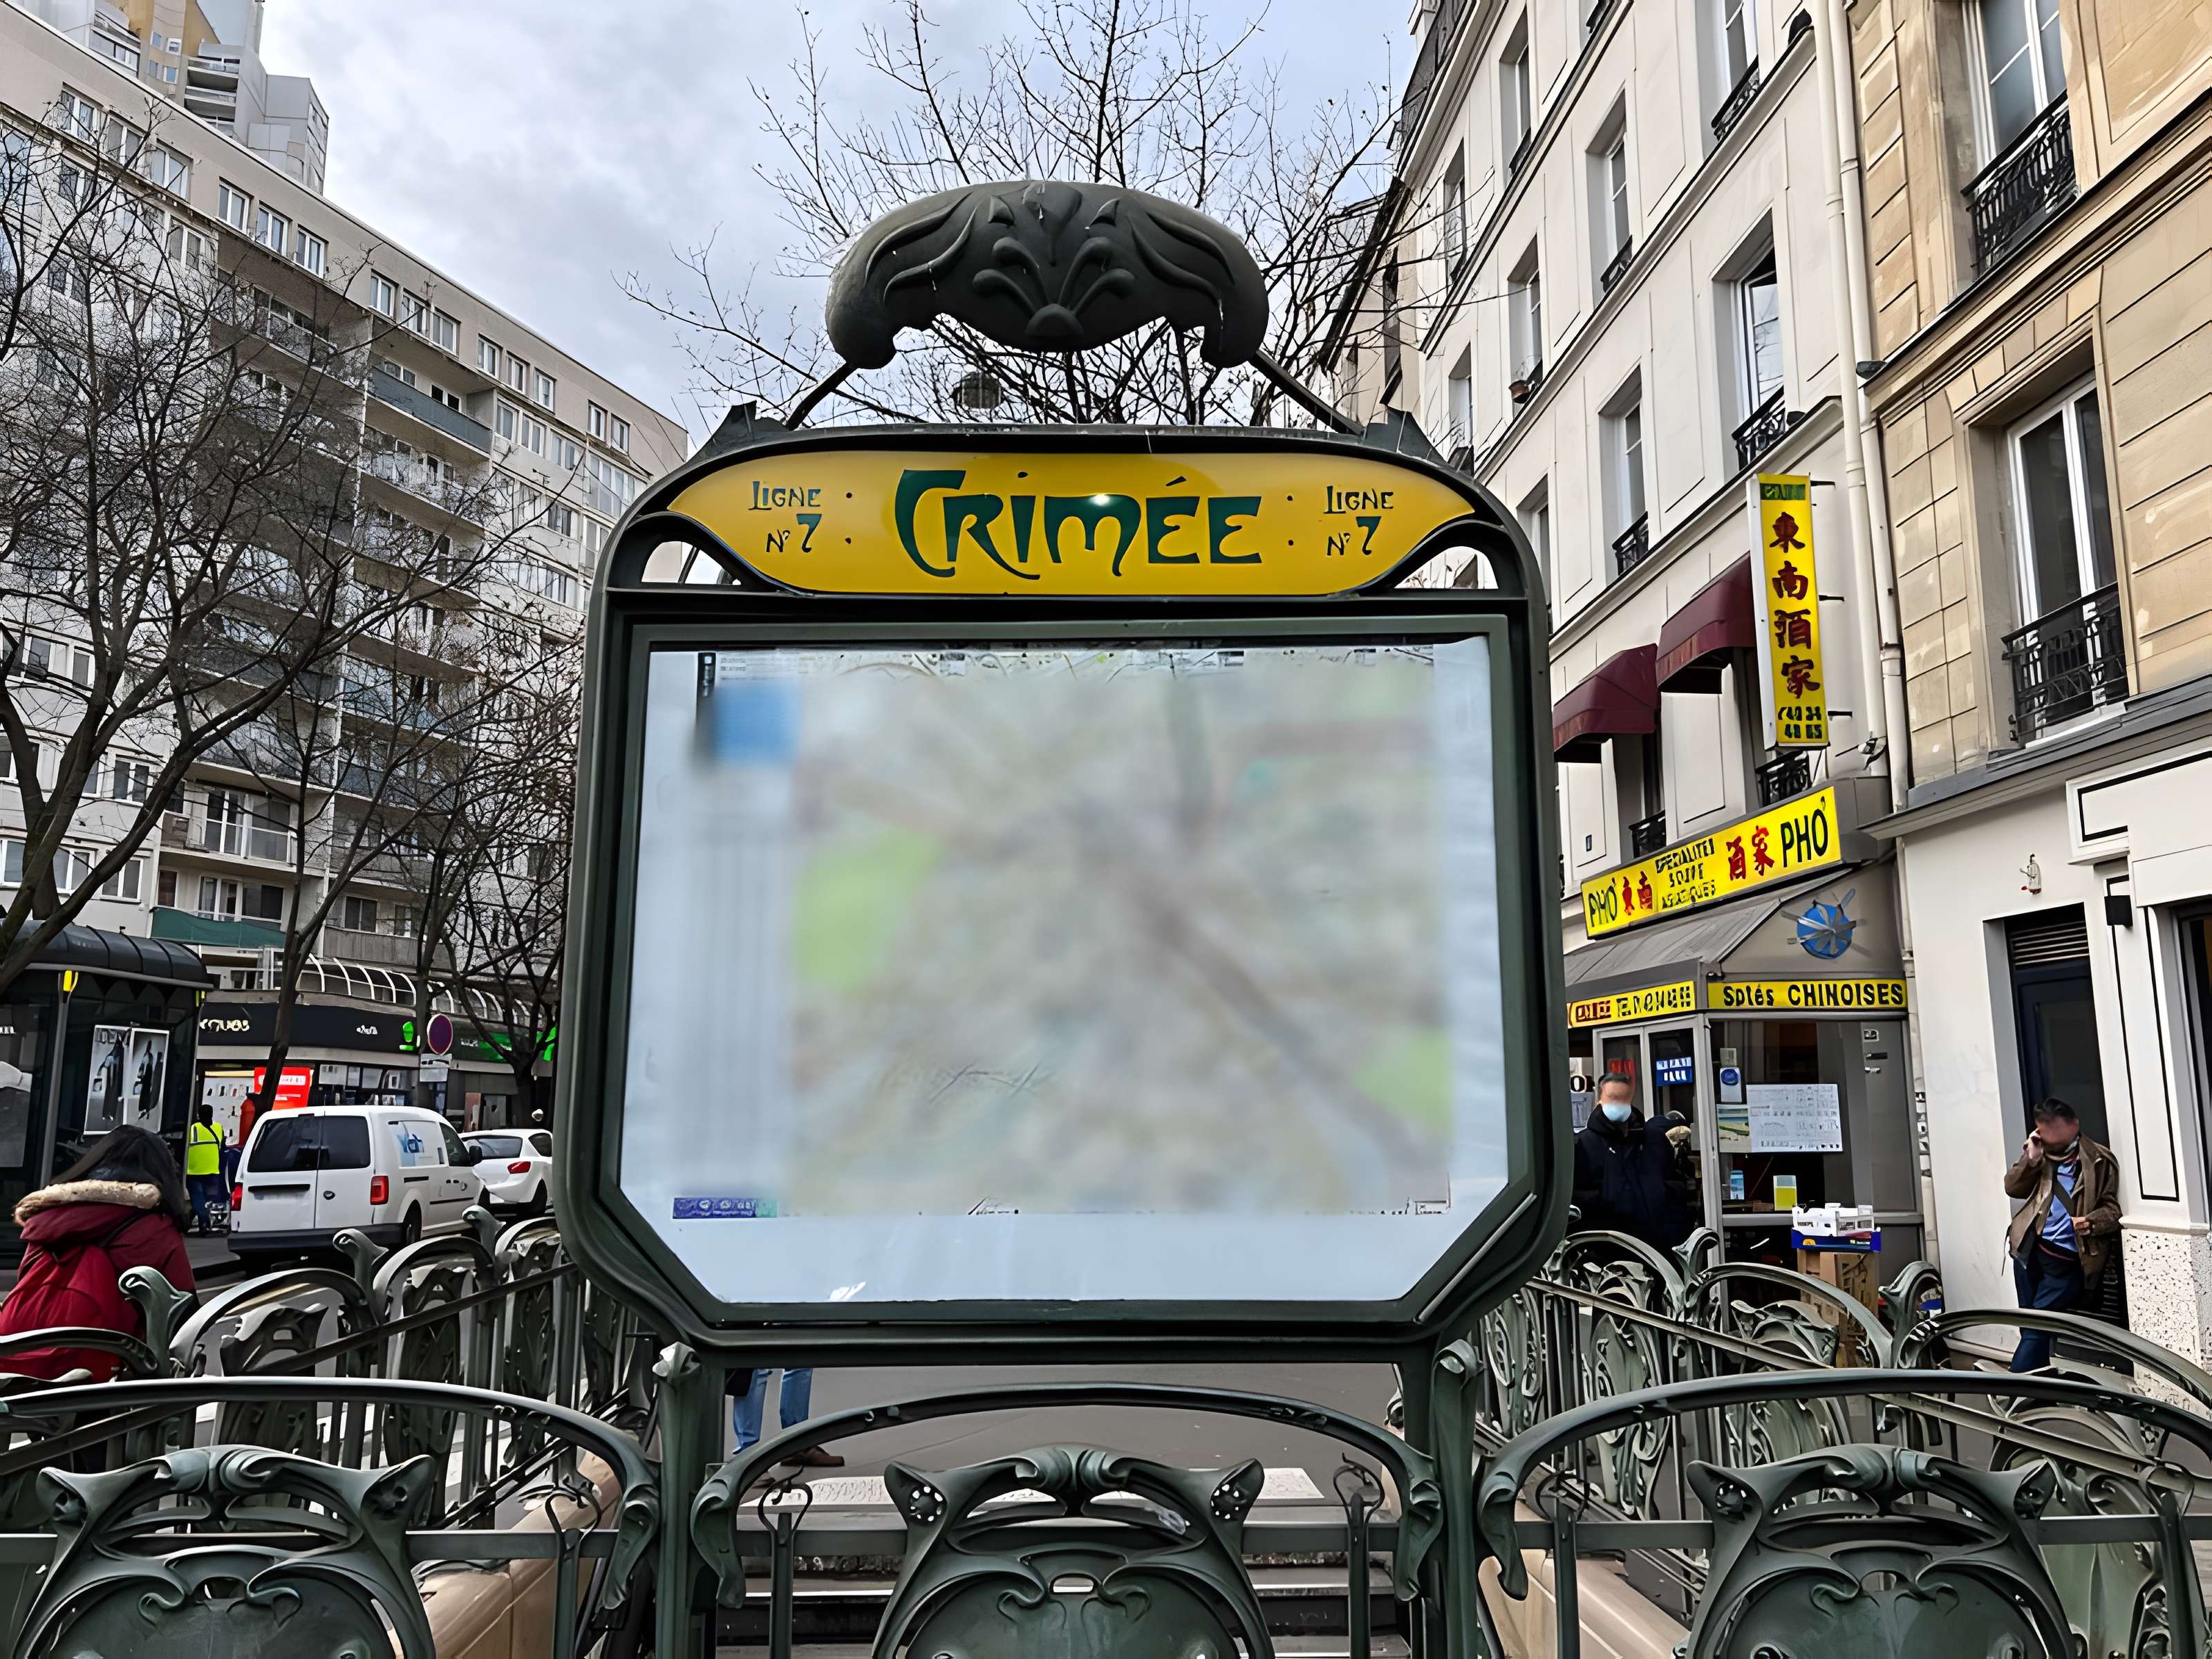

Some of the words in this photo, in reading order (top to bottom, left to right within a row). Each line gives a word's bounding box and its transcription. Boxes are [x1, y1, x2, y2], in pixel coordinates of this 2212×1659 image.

[748, 480, 821, 511] LIGNE
[1323, 485, 1394, 514] LIGNE
[796, 513, 823, 553] 7
[894, 469, 1262, 580] CRIMÉE
[1356, 516, 1382, 556] 7
[1788, 982, 1904, 1007] CHINOISES
